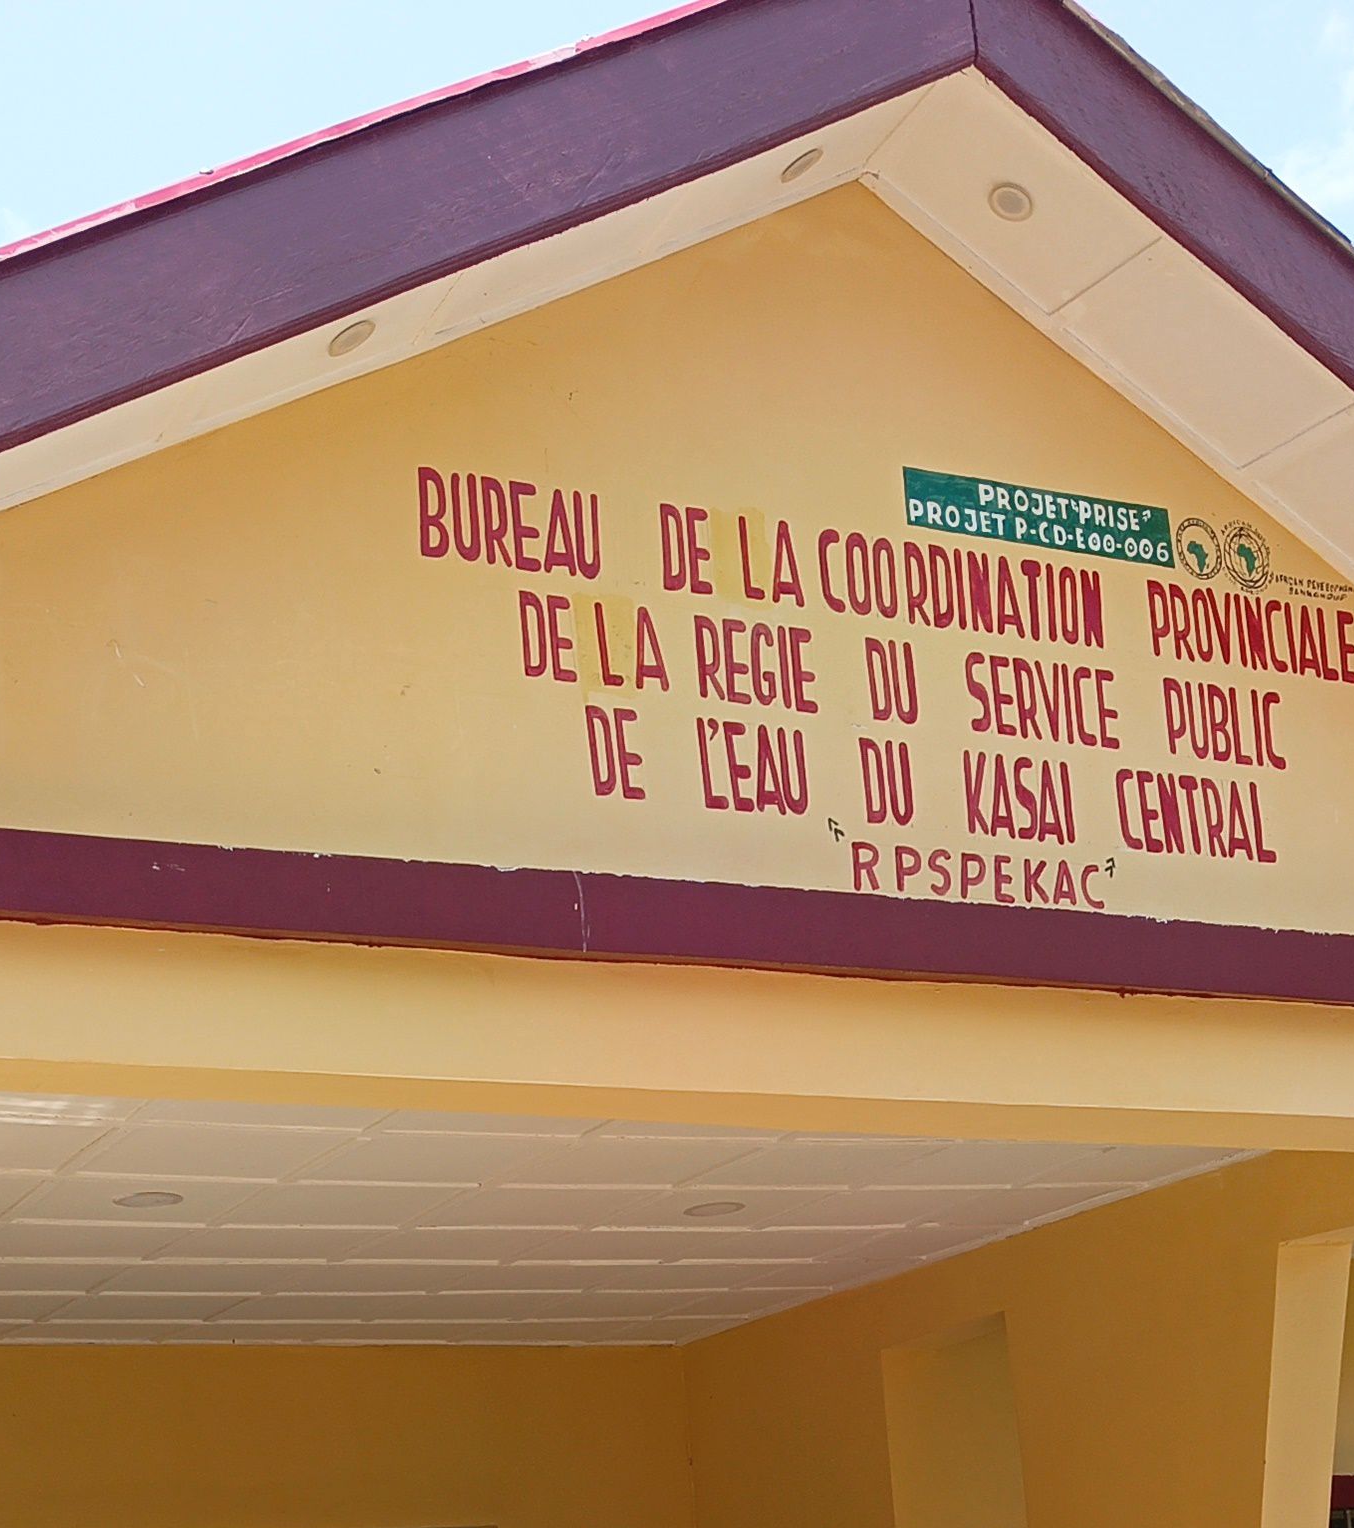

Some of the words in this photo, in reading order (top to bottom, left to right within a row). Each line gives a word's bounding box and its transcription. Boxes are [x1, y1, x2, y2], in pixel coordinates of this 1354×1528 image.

[417, 466, 601, 580] BUREAU
[659, 503, 713, 595] DE
[738, 515, 805, 608] LA
[818, 528, 1104, 649] COORDINATION
[908, 498, 1006, 536] PROJET
[978, 484, 1069, 520] PROJET
[518, 590, 578, 683] DE
[593, 601, 670, 692] LA
[694, 615, 819, 714] REGIE
[864, 638, 918, 725] DU
[965, 652, 1120, 750] SERVICE
[1162, 677, 1287, 771] PUBLIC
[585, 704, 646, 800] DE
[696, 718, 809, 816] L’EAU
[858, 737, 914, 826] DU
[963, 751, 1076, 846] KASAI
[1115, 768, 1277, 864] CENTRAL
